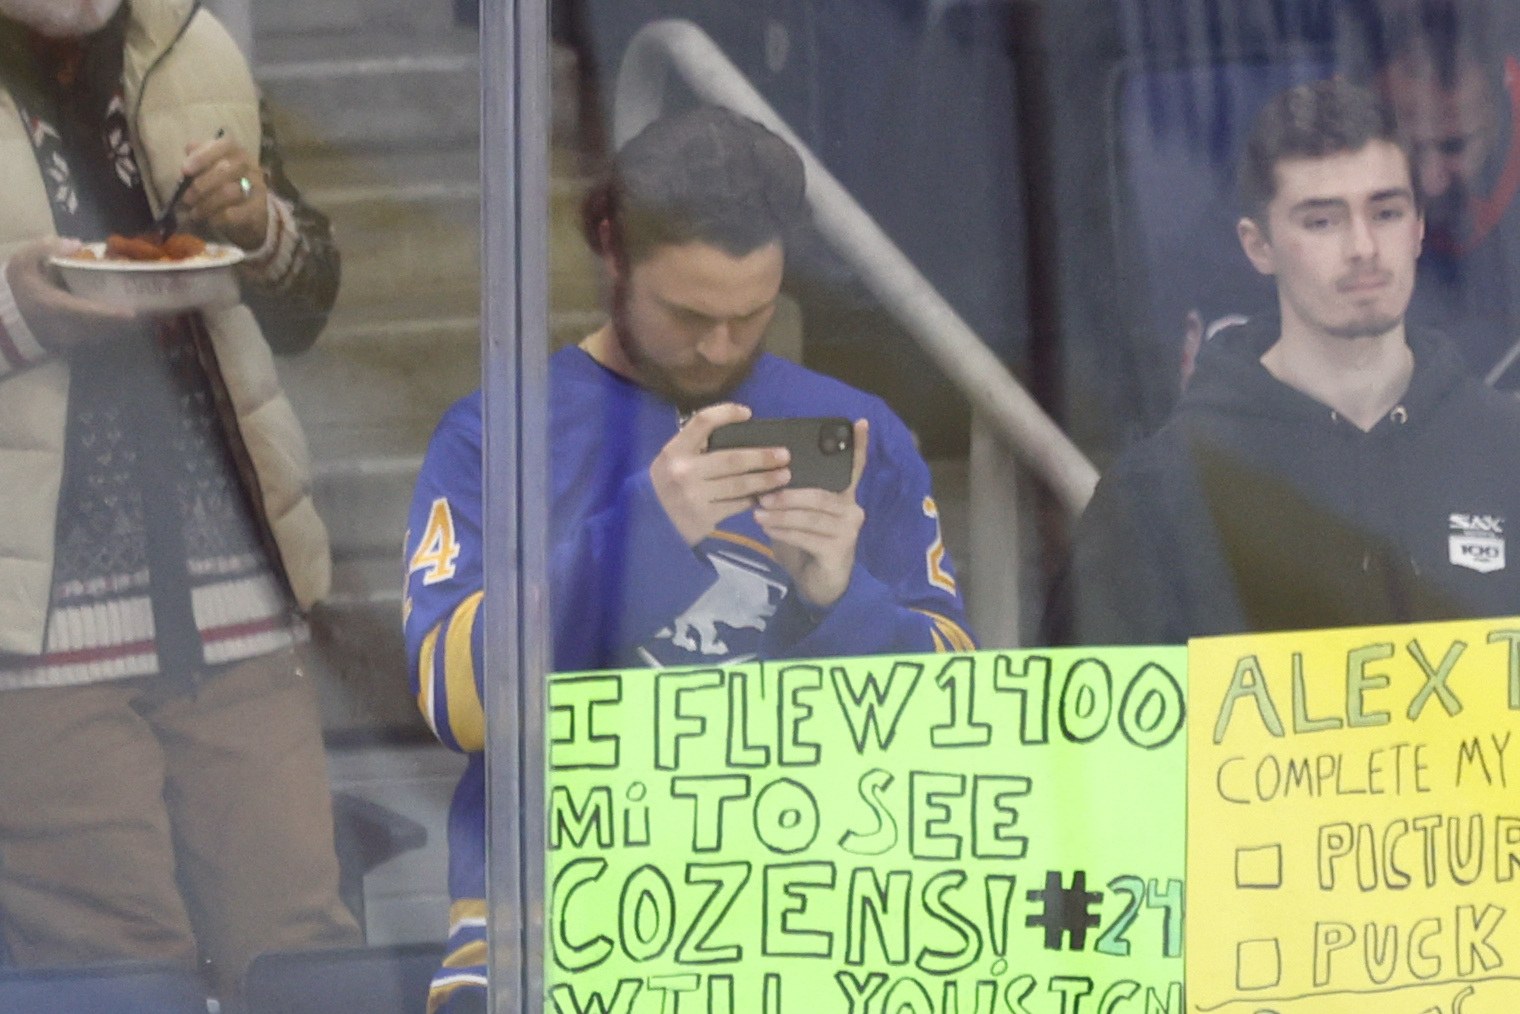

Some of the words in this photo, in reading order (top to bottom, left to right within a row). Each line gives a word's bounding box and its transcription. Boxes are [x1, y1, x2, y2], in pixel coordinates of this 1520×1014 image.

[548, 675, 622, 769] I
[654, 662, 924, 770] FLEW
[930, 655, 1186, 749] 1400
[1214, 638, 1468, 744] ALEX
[671, 774, 820, 854] TO
[839, 768, 1032, 860] SEE
[1217, 744, 1430, 804] COMPLETE
[1456, 732, 1510, 788] MY
[553, 857, 1016, 977] COZENS!
[1024, 869, 1184, 957] #24
[1313, 904, 1505, 987] PUCK
